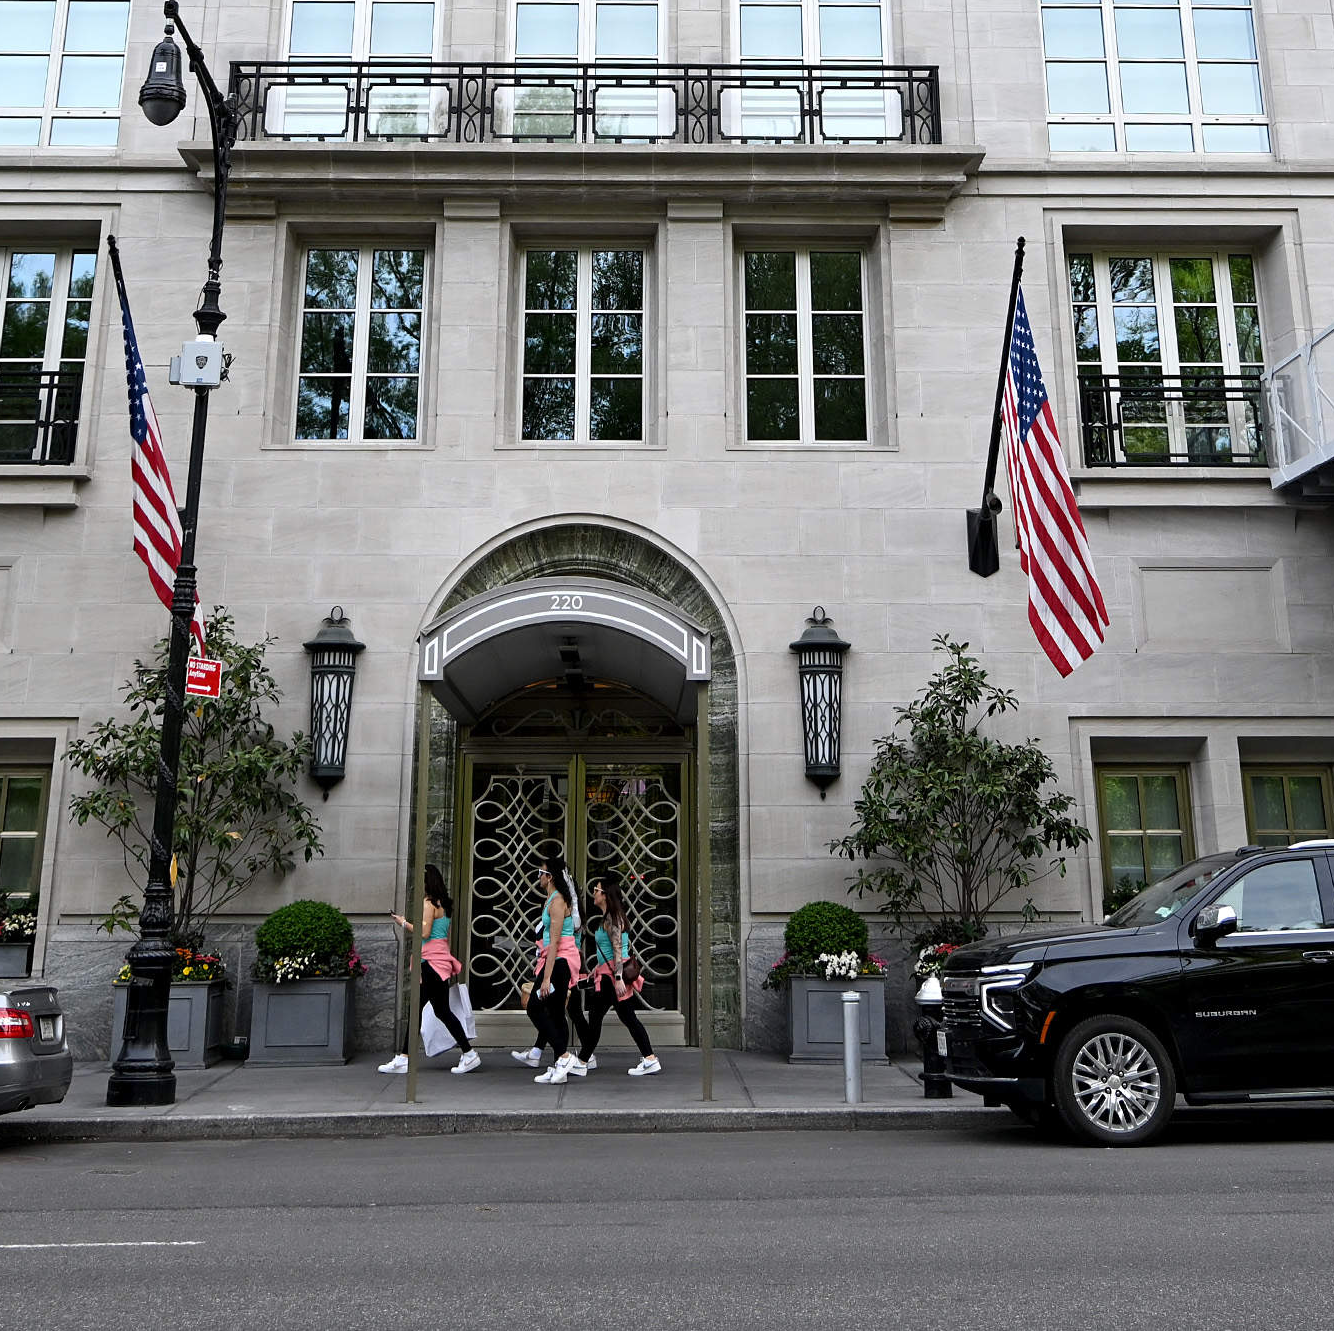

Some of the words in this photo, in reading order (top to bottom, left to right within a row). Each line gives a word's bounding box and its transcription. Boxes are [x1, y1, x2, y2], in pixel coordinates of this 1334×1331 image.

[550, 595, 583, 610] 220
[189, 661, 196, 669] NO
[196, 662, 217, 672] STANDING
[1194, 1009, 1257, 1018] SUBURBAN
